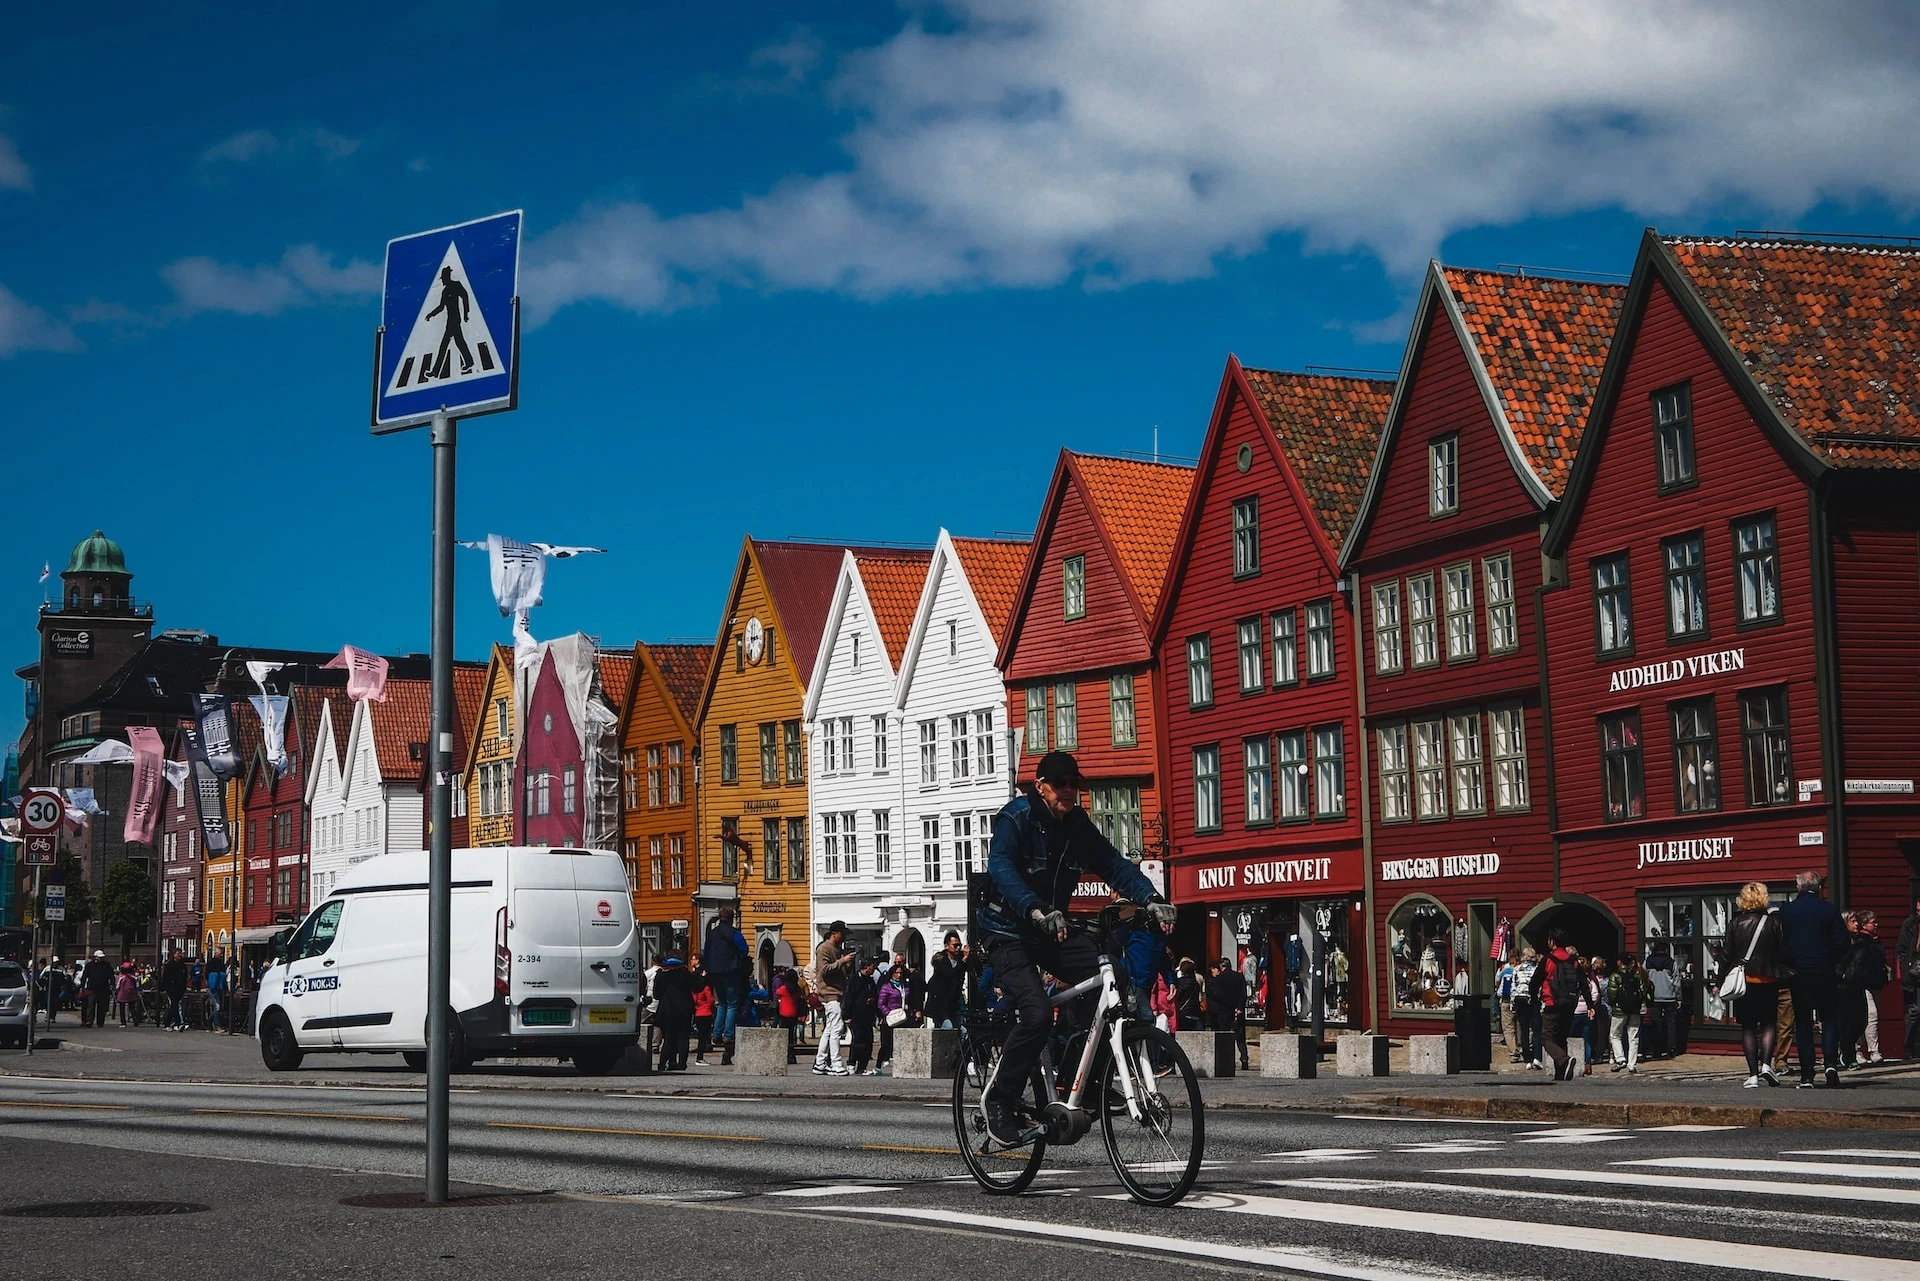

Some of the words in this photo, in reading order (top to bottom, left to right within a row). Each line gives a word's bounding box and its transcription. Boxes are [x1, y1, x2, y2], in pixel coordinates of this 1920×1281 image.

[51, 632, 77, 642] Clarion
[1609, 659, 1685, 692] AUDHILD
[1686, 648, 1745, 678] VIKEN
[28, 801, 58, 823] 30
[475, 821, 500, 841] ALFRED
[1637, 836, 1734, 870] JULEHUSET
[1198, 865, 1236, 890] KNUT
[1243, 857, 1331, 885] SKURTVEIT
[1381, 857, 1440, 881] BRYGGEN
[1442, 853, 1501, 877] HUSFLID
[47, 898, 64, 906] Taxi
[517, 955, 542, 963] 2-394
[311, 978, 336, 990] NOKAS
[617, 972, 639, 980] NOKAS
